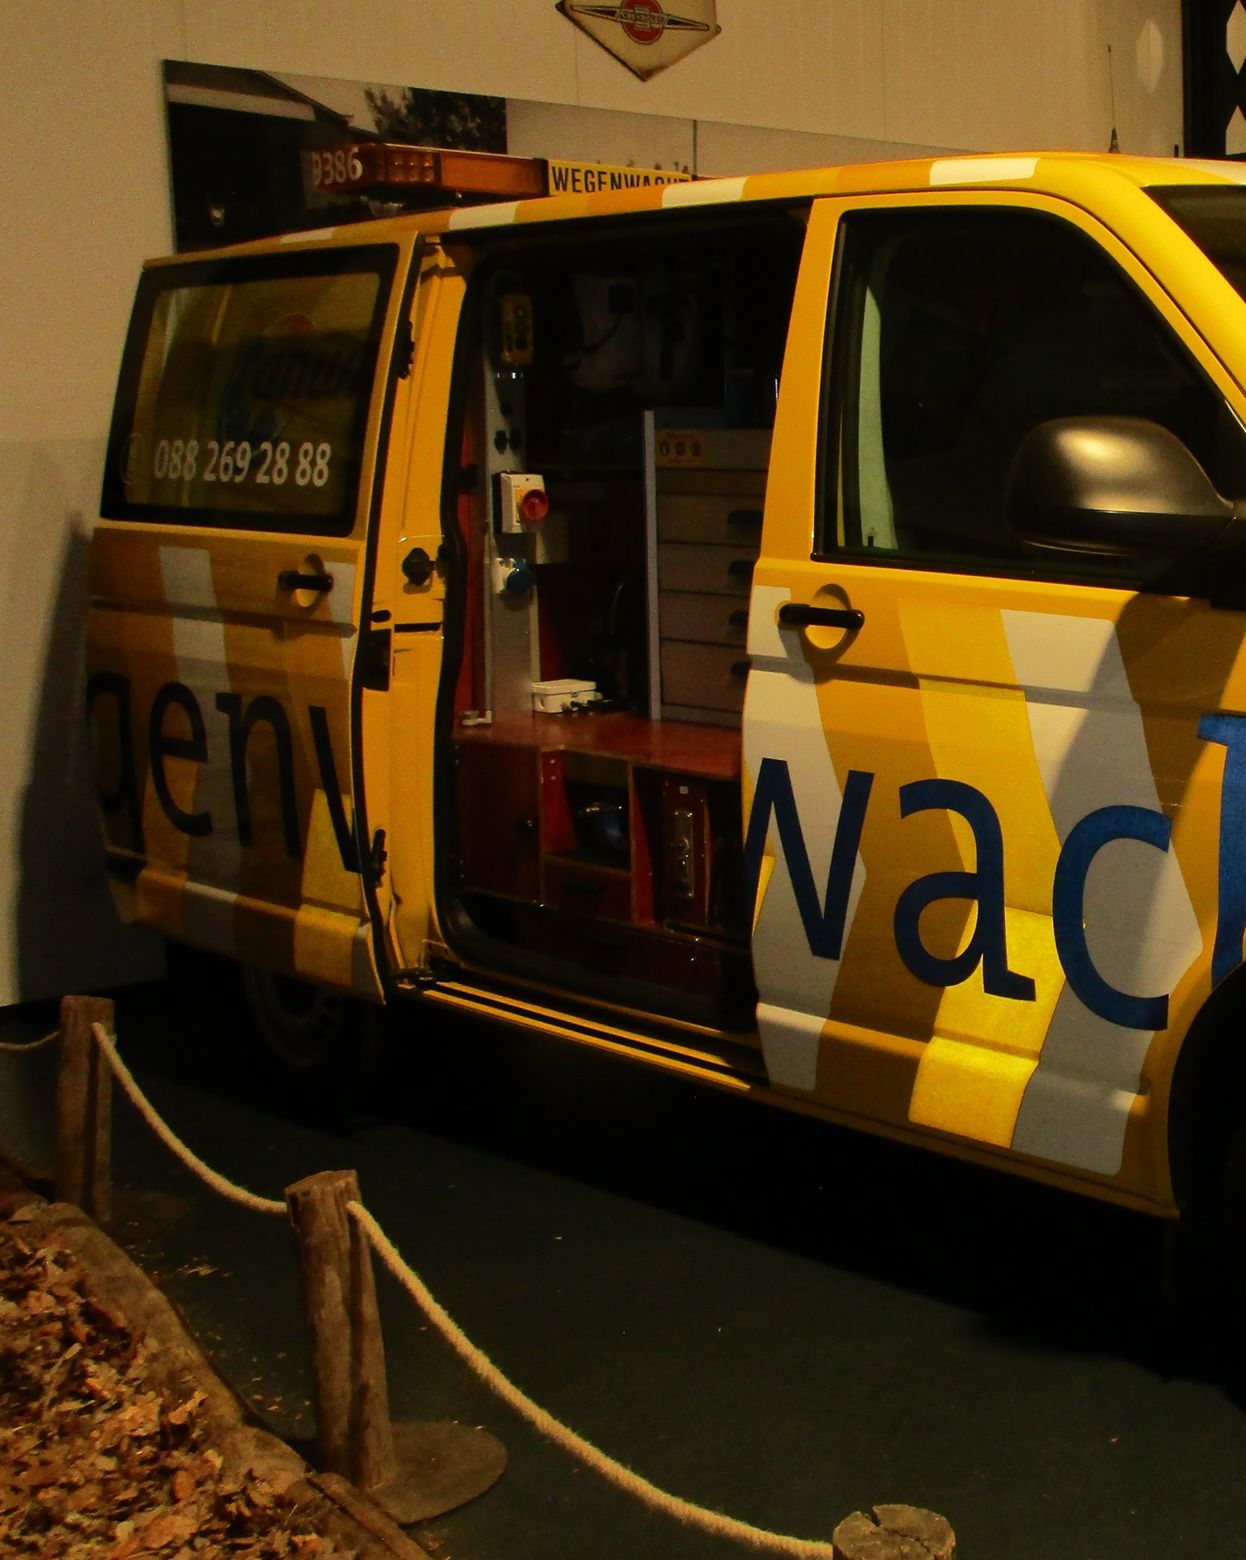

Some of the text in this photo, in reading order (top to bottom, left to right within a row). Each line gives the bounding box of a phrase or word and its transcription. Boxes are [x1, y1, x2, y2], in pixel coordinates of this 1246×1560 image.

[551, 166, 689, 193] WEGENWA
[154, 439, 332, 487] 088 269 28 88
